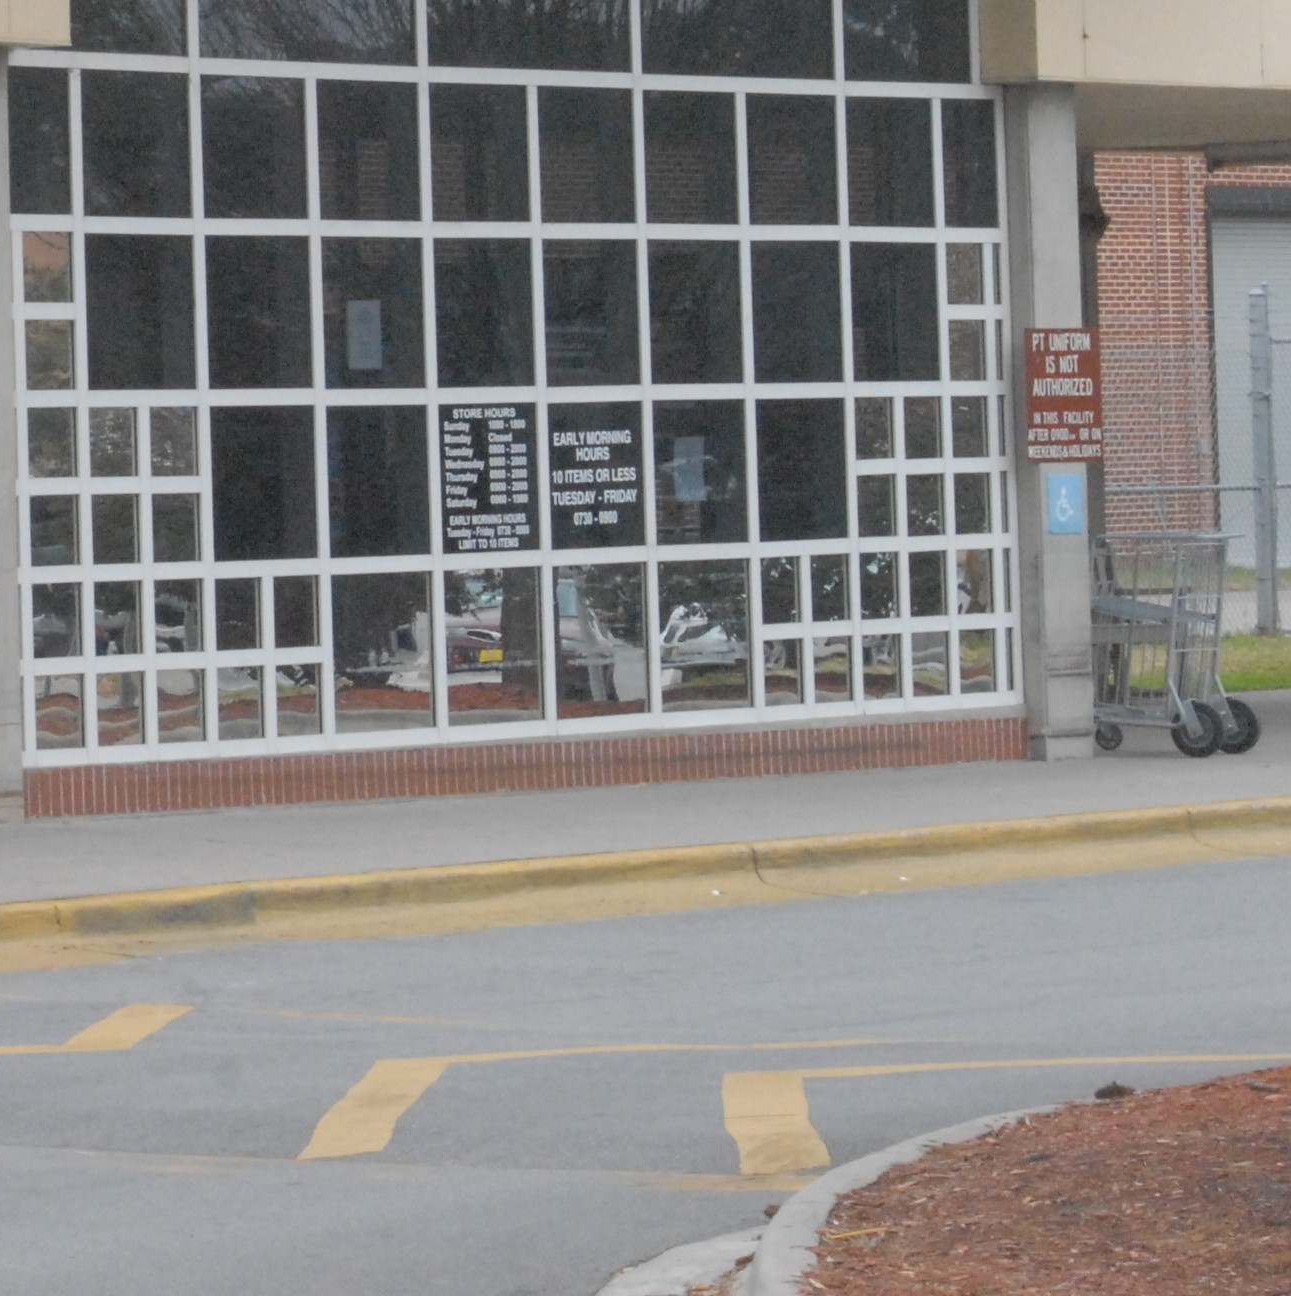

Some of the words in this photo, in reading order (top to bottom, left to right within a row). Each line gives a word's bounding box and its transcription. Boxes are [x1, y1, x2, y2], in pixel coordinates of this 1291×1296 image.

[1032, 333, 1045, 351] PT
[1049, 333, 1091, 351] UNIFORM
[1045, 355, 1056, 374] IS
[1060, 354, 1079, 373] NOT
[1033, 378, 1093, 397] AUTHORIZED
[452, 408, 483, 419] STORE
[484, 407, 516, 418] HOURS
[1033, 411, 1041, 424] IN
[1042, 411, 1058, 424] THIS
[1063, 411, 1094, 424] FACILITY
[553, 432, 585, 446] EARLY
[586, 430, 632, 444] MORNING
[1028, 428, 1049, 441] AFTER
[1079, 428, 1089, 441] OR
[576, 446, 610, 461] HOURS
[552, 470, 563, 484] 10
[565, 469, 594, 483] ITEMS
[595, 468, 610, 482] OR
[612, 467, 637, 481] LESS
[552, 491, 596, 506] TUESDAY
[604, 489, 637, 503] FRIDAY
[449, 515, 471, 526] EARLY
[471, 514, 502, 525] MORNING
[503, 513, 526, 524] HOURS
[478, 538, 488, 549] TO
[498, 537, 519, 548] ITEMS
